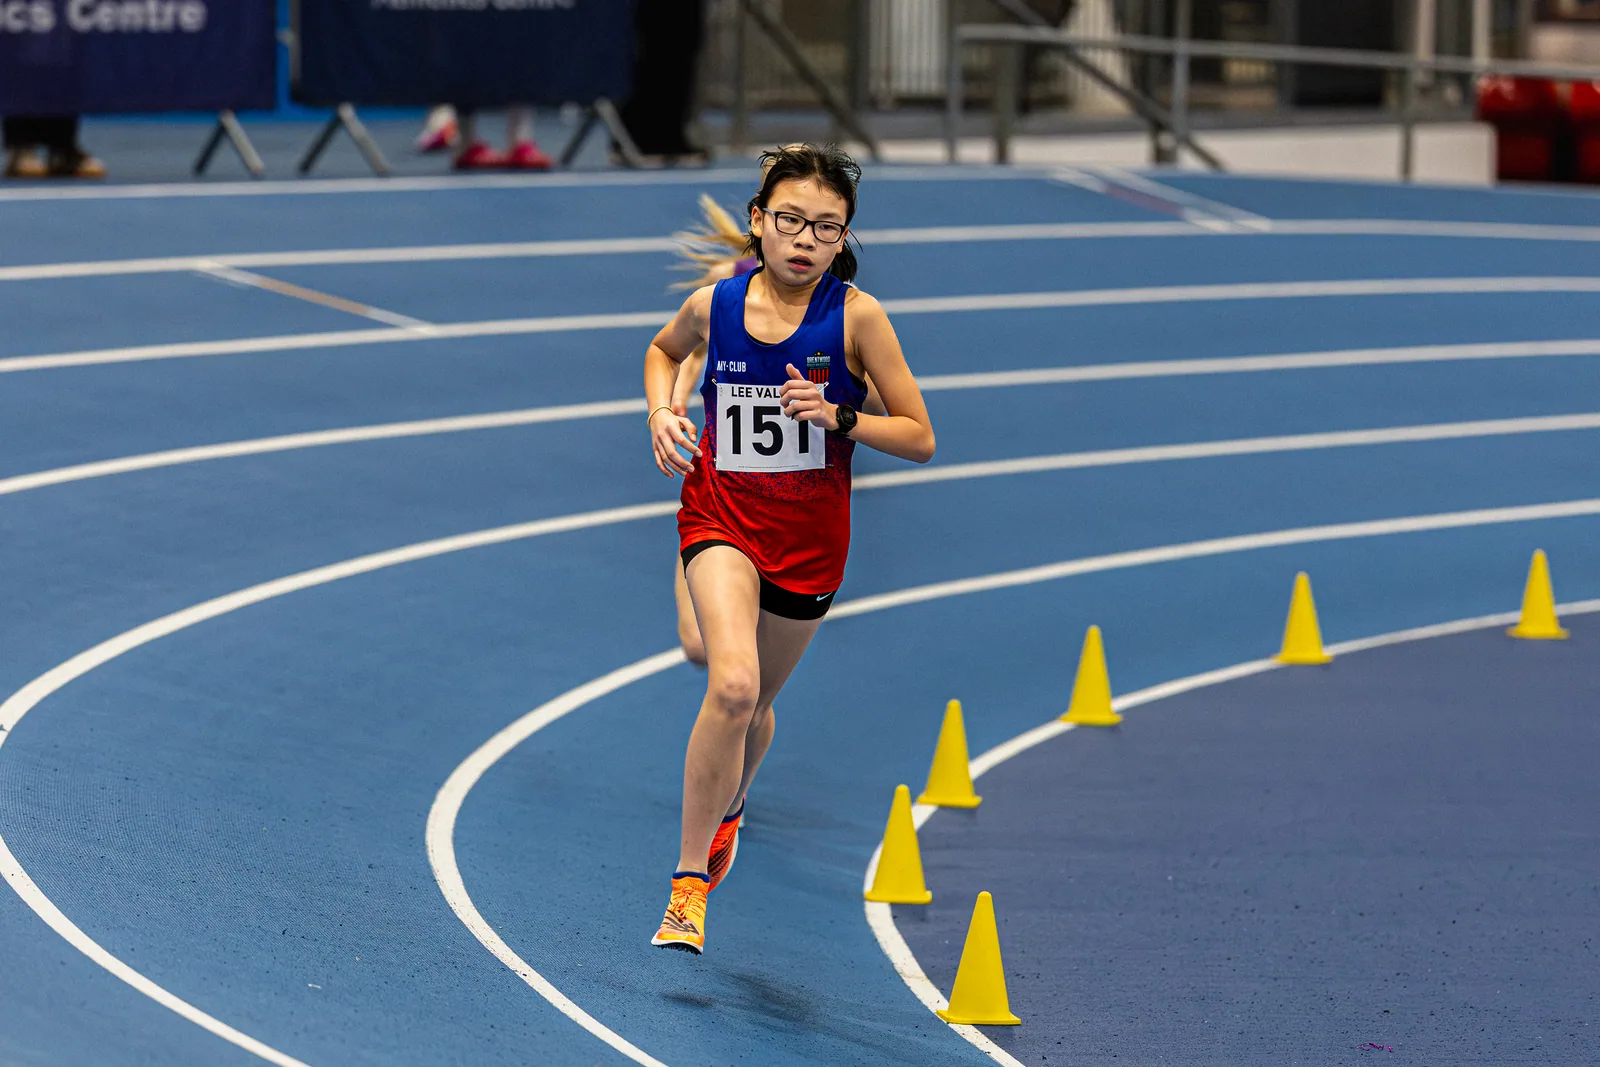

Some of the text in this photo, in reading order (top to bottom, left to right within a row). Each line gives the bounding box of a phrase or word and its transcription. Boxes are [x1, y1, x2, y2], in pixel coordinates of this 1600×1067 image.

[66, 0, 206, 33] Centre
[731, 386, 781, 399] LEE VAL
[726, 405, 809, 456] 151
